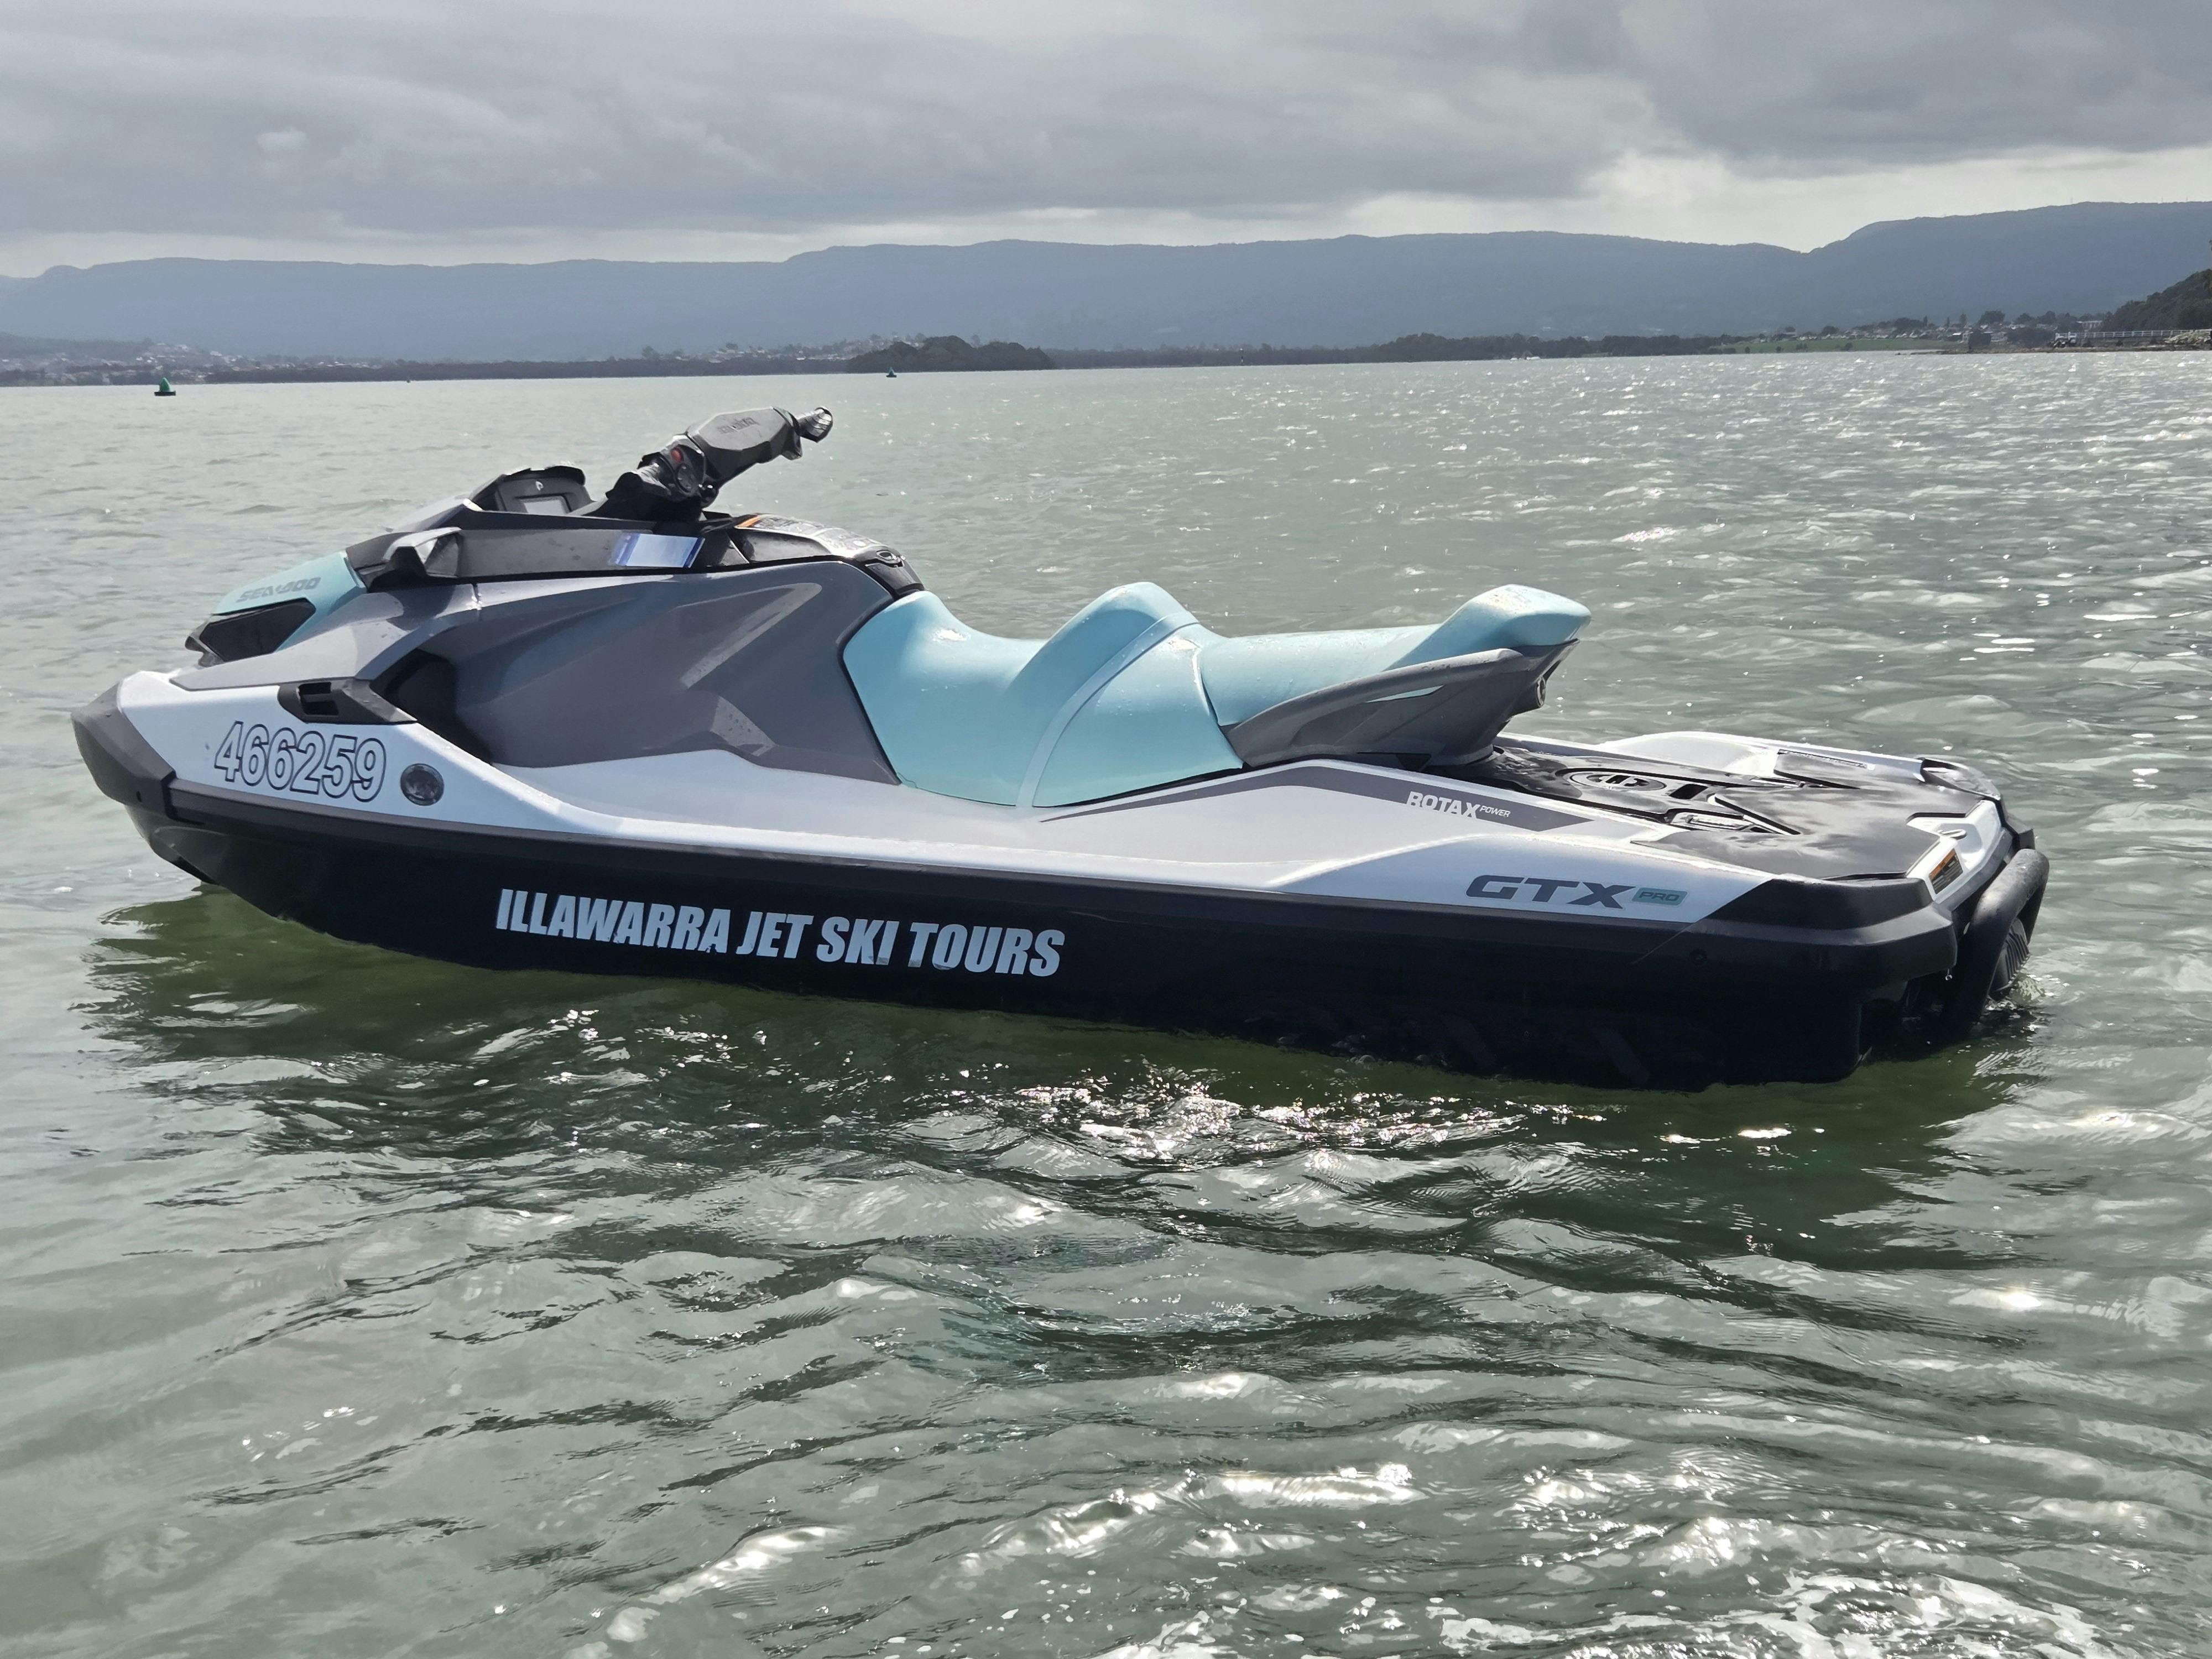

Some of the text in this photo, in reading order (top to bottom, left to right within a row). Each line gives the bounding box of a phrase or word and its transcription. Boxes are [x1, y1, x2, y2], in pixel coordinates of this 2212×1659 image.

[214, 721, 387, 802] 466259
[1406, 791, 1511, 818] ROTAX POWER
[1465, 874, 1681, 909] GTX PRO
[496, 888, 1065, 977] ILLAWARRA JET SKI TOURS
